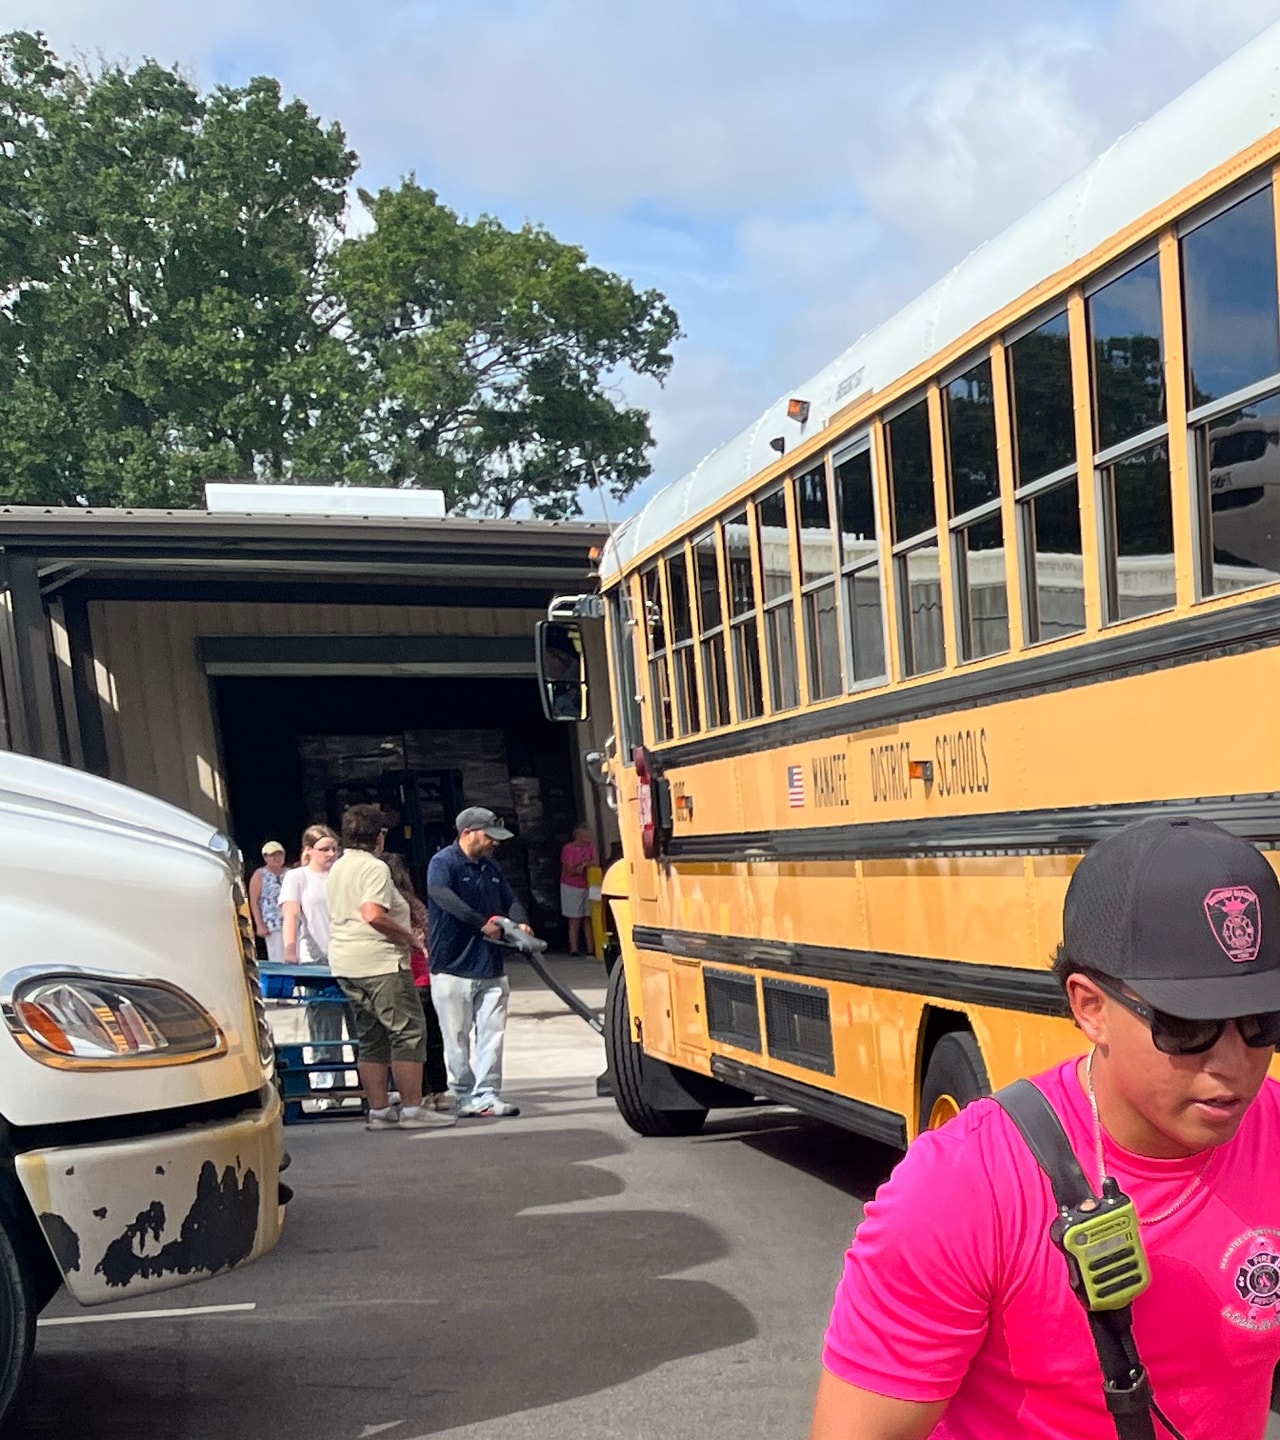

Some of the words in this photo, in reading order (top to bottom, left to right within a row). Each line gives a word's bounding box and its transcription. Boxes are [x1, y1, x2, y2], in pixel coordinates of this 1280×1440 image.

[811, 753, 850, 808] MANATEE
[870, 741, 913, 803] DISTRICT
[935, 726, 990, 799] SCHOOLS
[1253, 1254, 1273, 1266] FIRE
